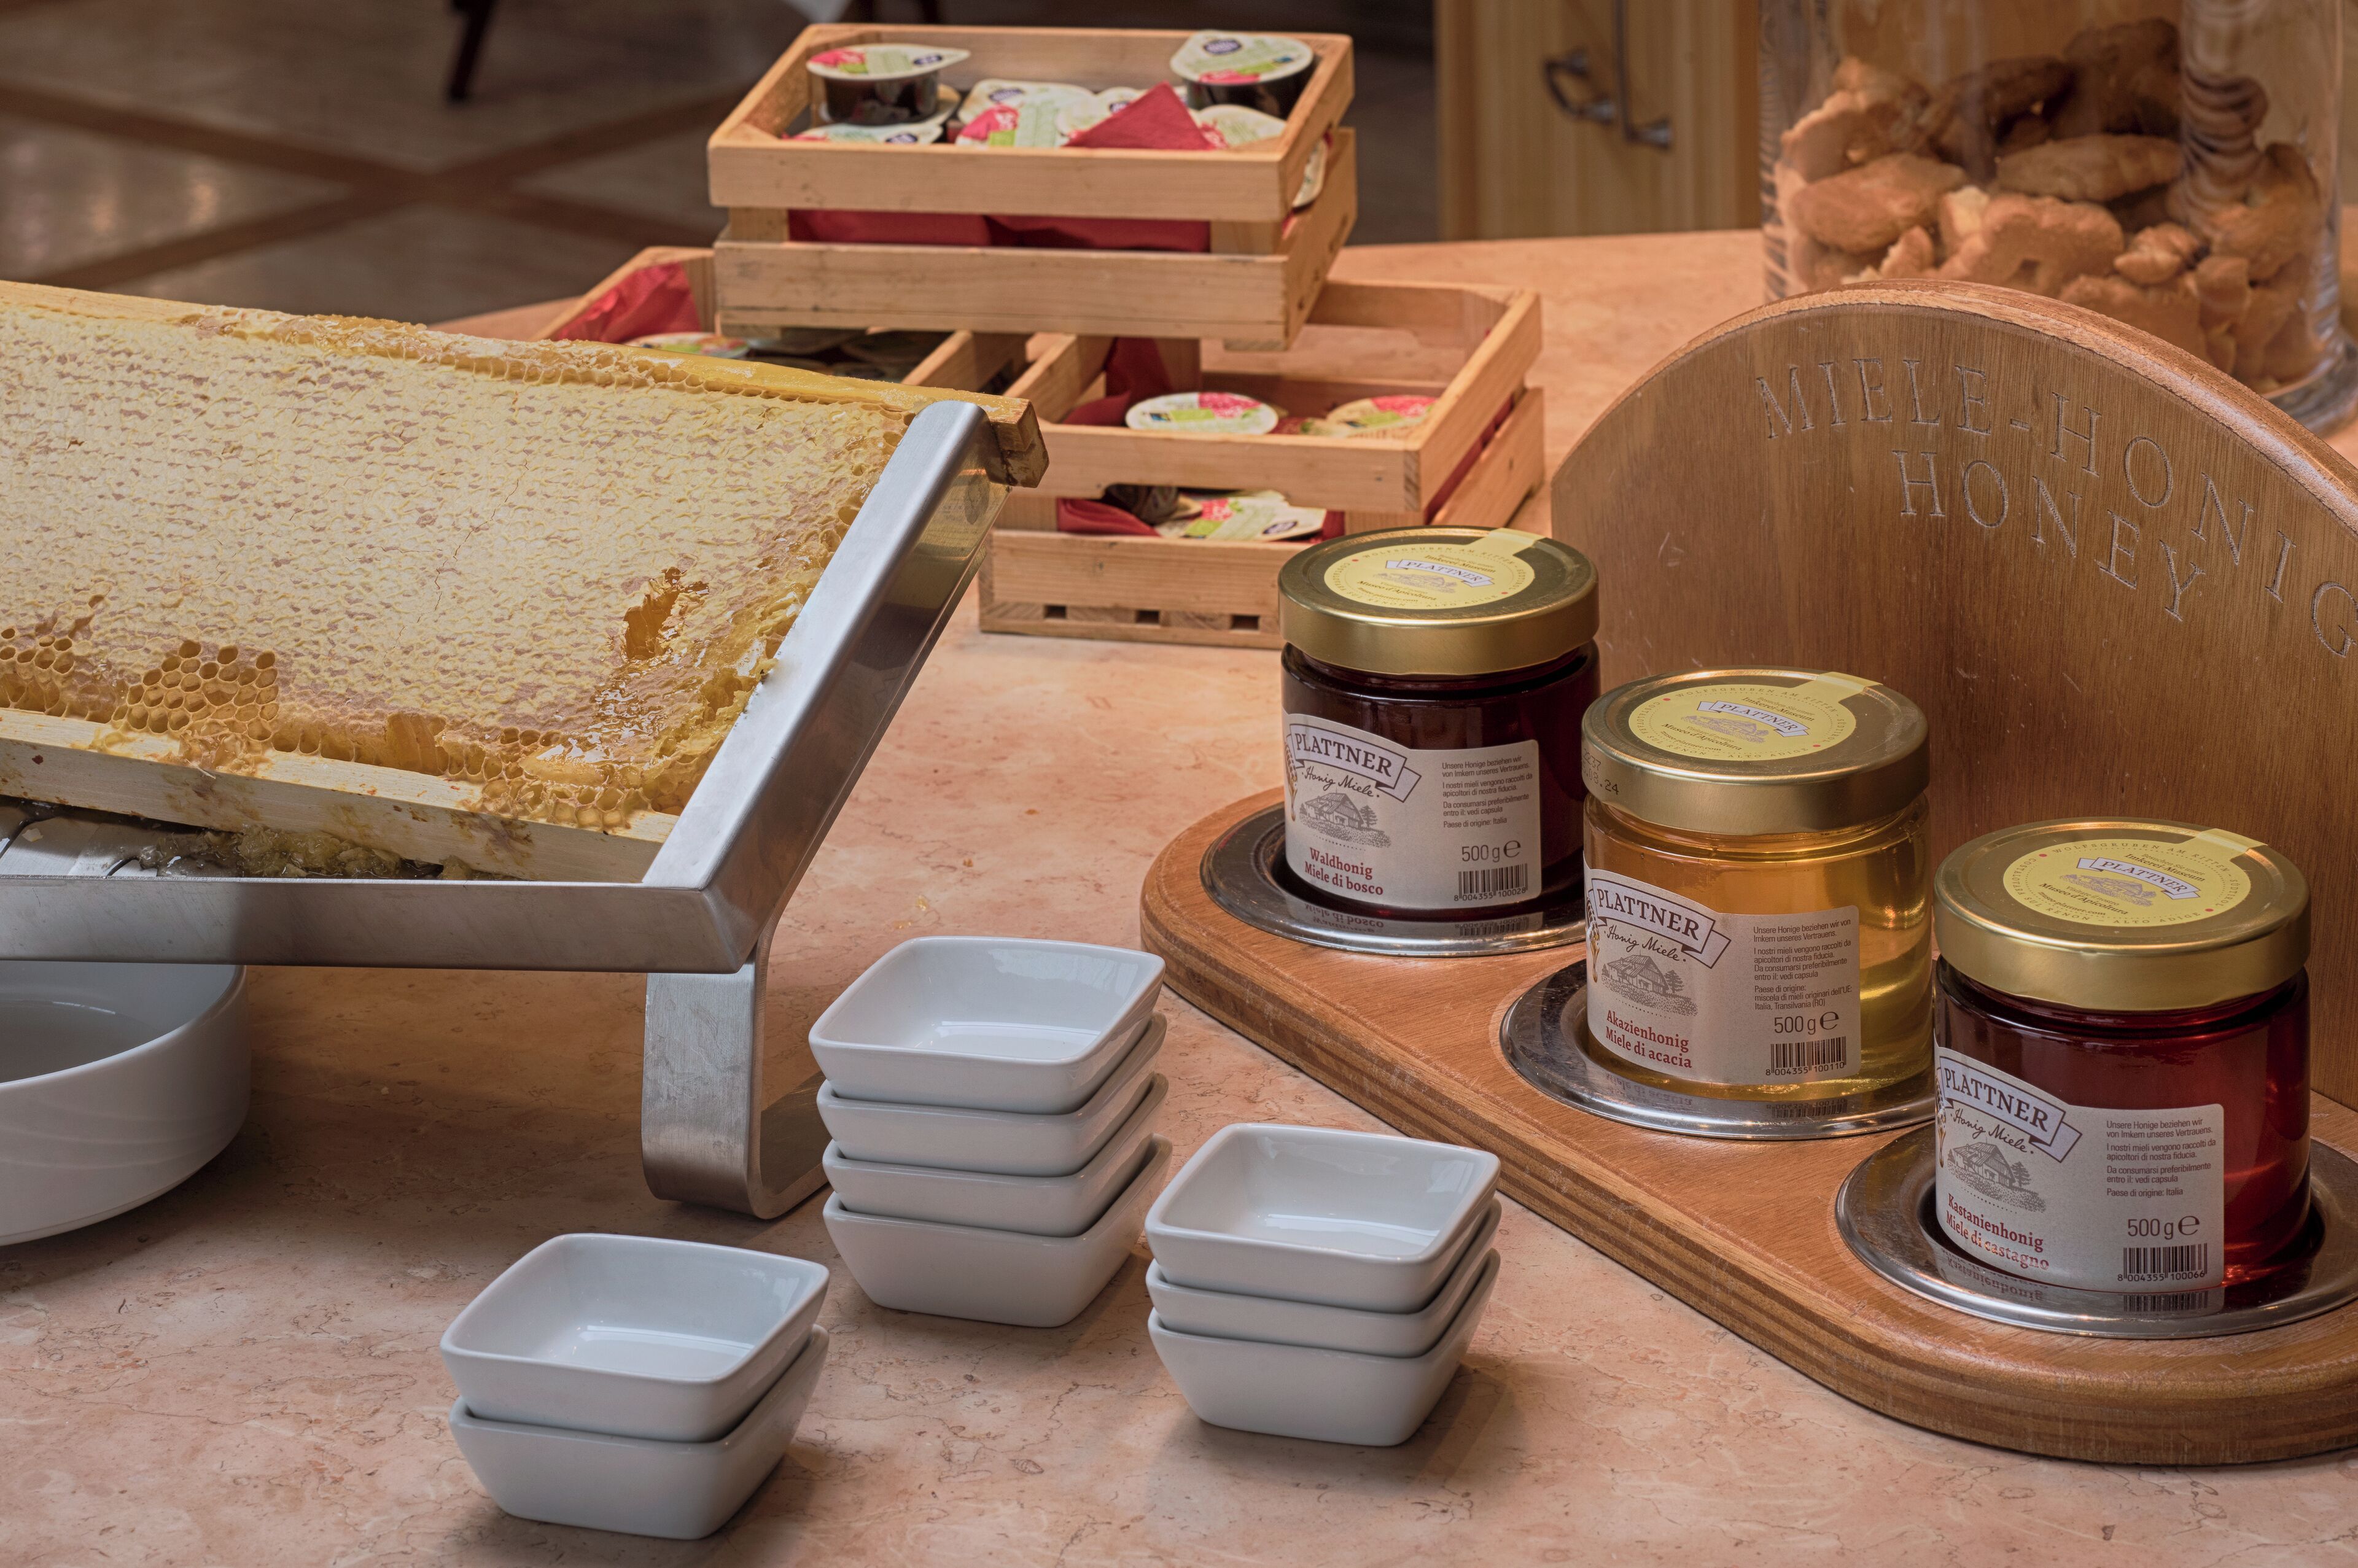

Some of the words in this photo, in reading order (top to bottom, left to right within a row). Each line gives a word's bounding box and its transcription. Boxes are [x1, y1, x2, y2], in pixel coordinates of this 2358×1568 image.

[1891, 449, 2206, 623] HONEY
[1406, 561, 1483, 582] PLATTNER
[1719, 704, 1798, 731] PLATTNER
[1661, 723, 1691, 737] Museo
[1294, 733, 1391, 777] PLATTNER
[1487, 758, 1512, 766] beziehen
[1304, 766, 1336, 791] Honig
[1338, 775, 1373, 797] Miele
[1481, 806, 1503, 815] capsula
[1310, 847, 1372, 880] Waldhonig
[2125, 854, 2206, 882] Imkerei-Museum
[1305, 861, 1329, 883] Miele
[1333, 874, 1343, 887] di
[1346, 877, 1383, 895] bosco
[2099, 861, 2188, 892] PLATTNER
[2039, 883, 2071, 898] Museo
[1597, 889, 1699, 941] PLATTNER
[1802, 923, 1829, 932] beziehen
[1607, 924, 1640, 952] Honig
[1642, 936, 1679, 961] Miele
[1794, 945, 1820, 954] vengono
[1822, 941, 1843, 950] raccolti
[1754, 956, 1783, 964] apicoltori
[1792, 953, 1811, 962] nostra
[1765, 963, 1800, 972] consumarsi
[1803, 958, 1847, 971] preferibilmente
[1794, 971, 1818, 980] capsula
[1783, 985, 1806, 993] origine:
[1805, 990, 1829, 999] originari
[1775, 999, 1811, 1009] Transilvania
[1813, 999, 1825, 1008] (RO)
[1606, 1010, 1689, 1053] Akazienhonig
[1774, 1016, 1804, 1033] 500
[1606, 1027, 1631, 1050] Miele
[1634, 1041, 1646, 1057] di
[1649, 1050, 1692, 1068] acacia
[1944, 1068, 2049, 1132] PLATTNER
[1953, 1108, 1986, 1139] Honig
[1988, 1124, 2028, 1153] Miele
[2134, 1121, 2158, 1130] Honige
[2160, 1120, 2190, 1128] beziehen
[2151, 1144, 2181, 1152] vengono
[2182, 1139, 2206, 1149] raccolti
[2208, 1138, 2216, 1147] da
[2107, 1153, 2139, 1162] apicoltori
[2141, 1152, 2147, 1161] di
[2119, 1165, 2158, 1174] consumarsi
[2160, 1162, 2211, 1175] preferibilmente
[2135, 1175, 2149, 1184] vedi
[2152, 1175, 2178, 1184] capsula
[2138, 1189, 2164, 1198] origine:
[1948, 1193, 2044, 1253] Kastanienhonig
[2128, 1218, 2160, 1236] 500
[1946, 1210, 1969, 1240] Miele
[1971, 1230, 1982, 1248] di
[1985, 1240, 2049, 1270] castagno
